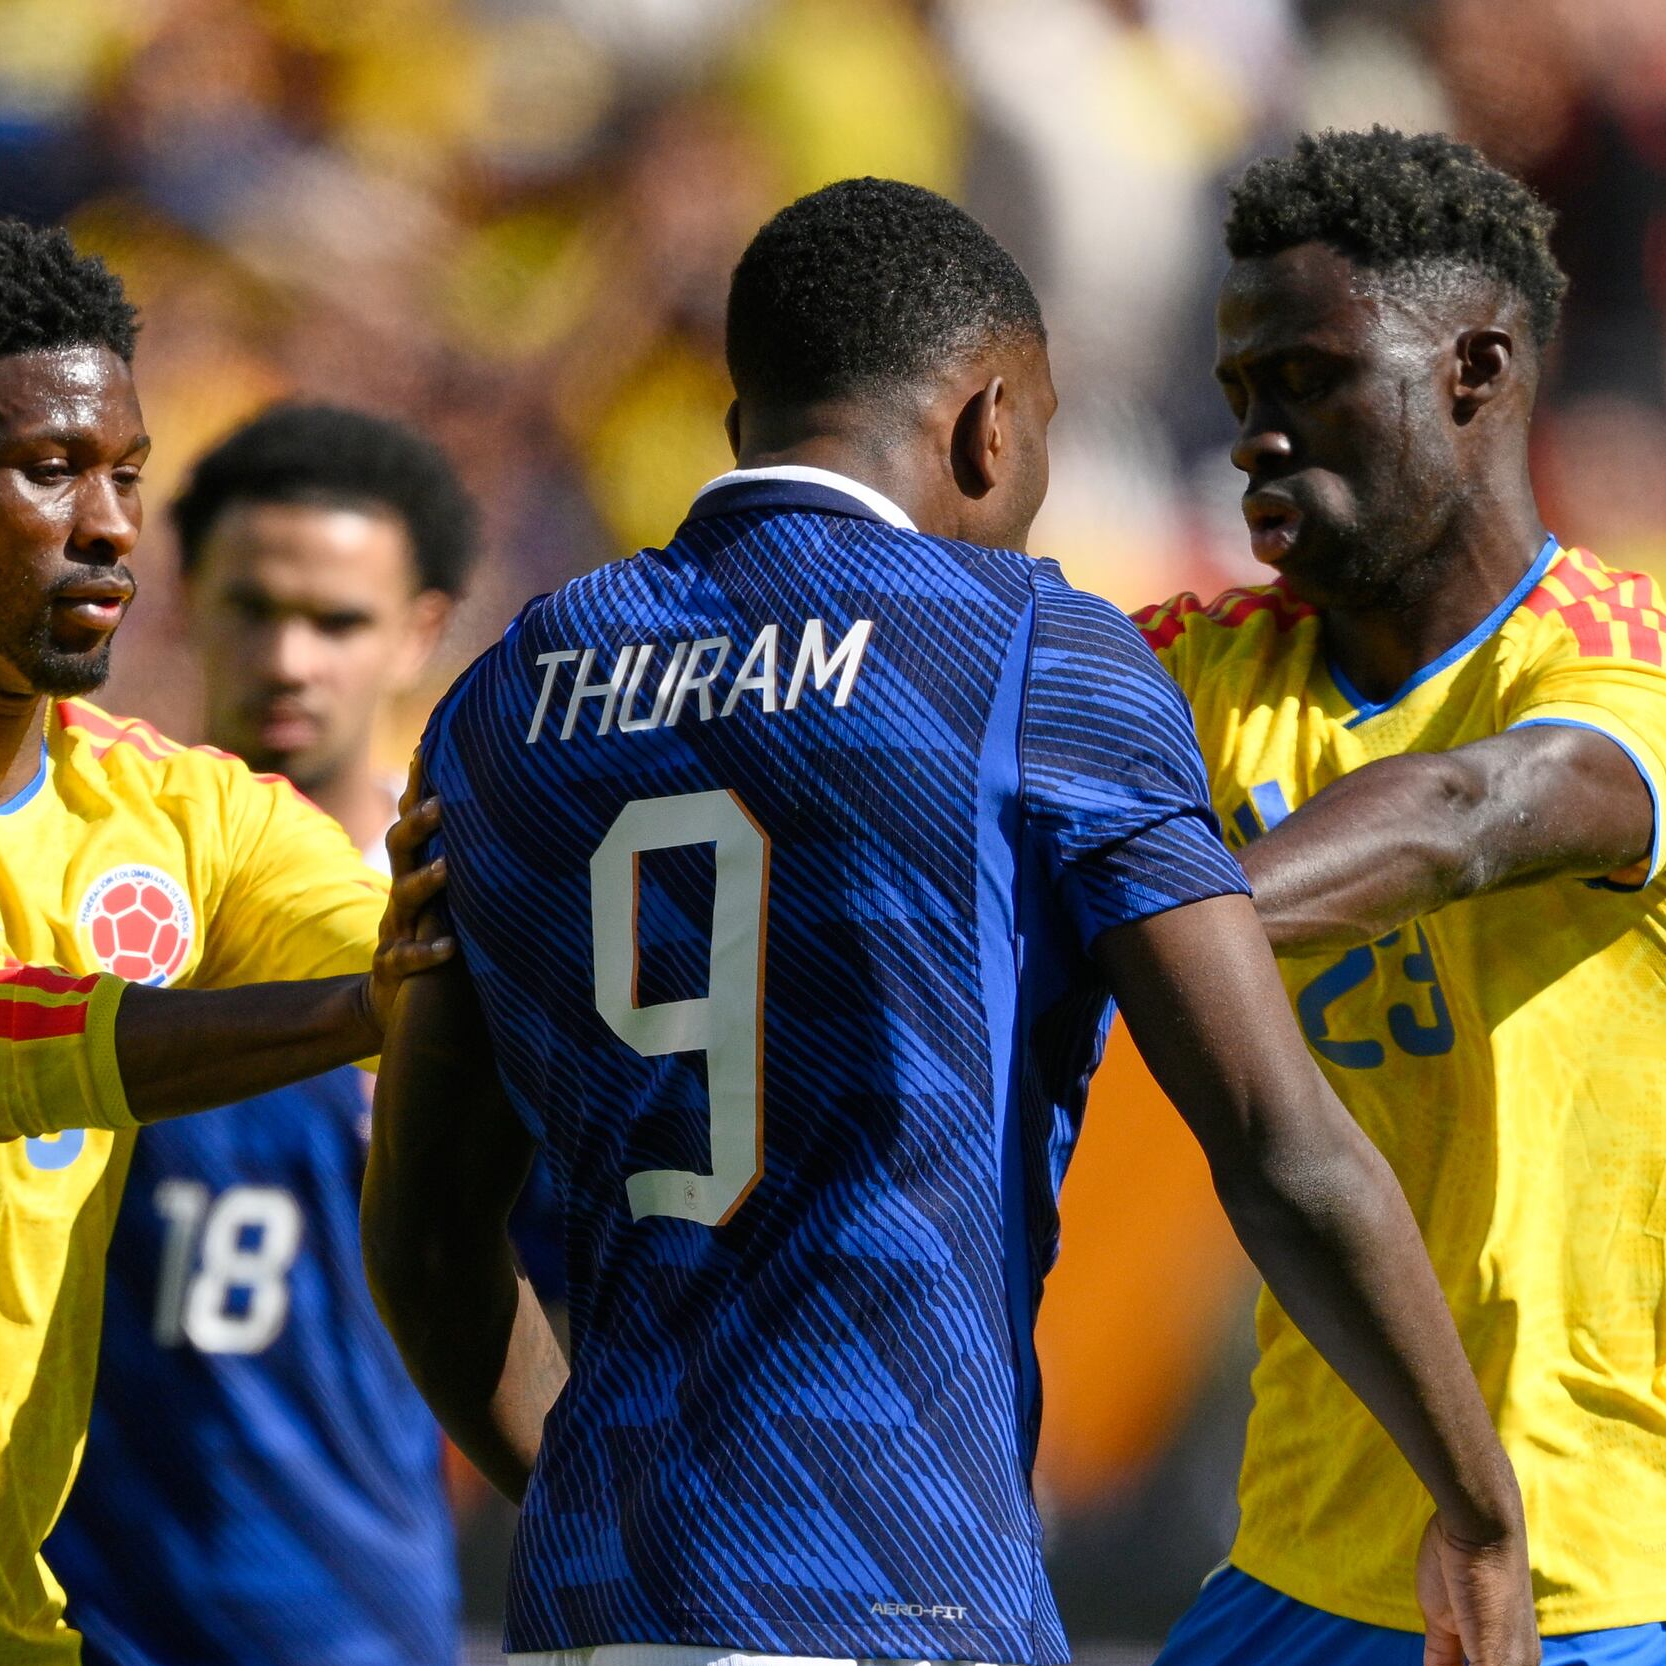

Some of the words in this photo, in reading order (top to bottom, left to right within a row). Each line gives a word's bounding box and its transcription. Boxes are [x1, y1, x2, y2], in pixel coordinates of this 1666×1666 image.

[526, 618, 873, 744] THURAM
[589, 789, 771, 1227] 9
[152, 1180, 305, 1355] 18
[870, 1602, 968, 1620] AERO-FIT
